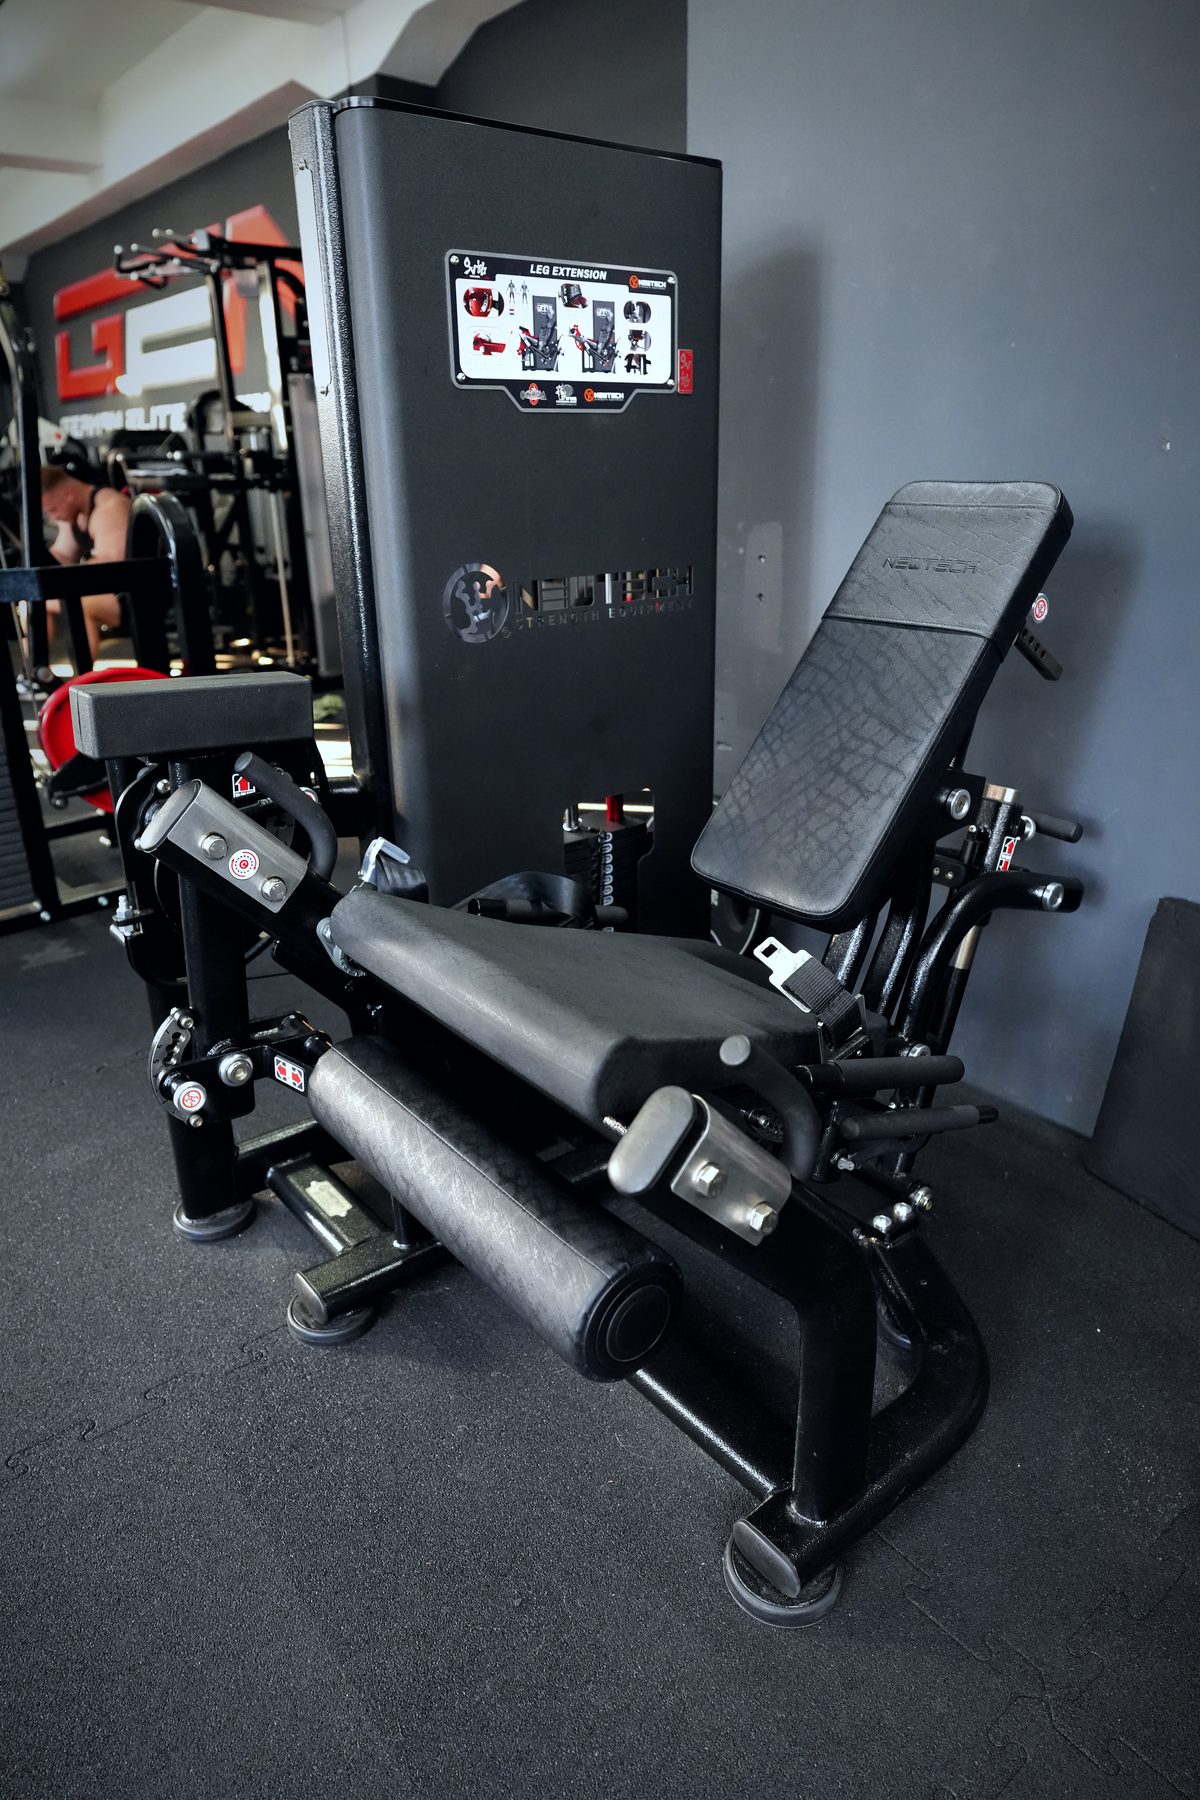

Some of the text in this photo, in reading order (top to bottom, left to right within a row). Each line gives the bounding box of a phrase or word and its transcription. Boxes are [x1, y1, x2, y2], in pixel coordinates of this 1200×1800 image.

[530, 263, 607, 281] LEG EXTENSION
[125, 402, 187, 432] ELITE
